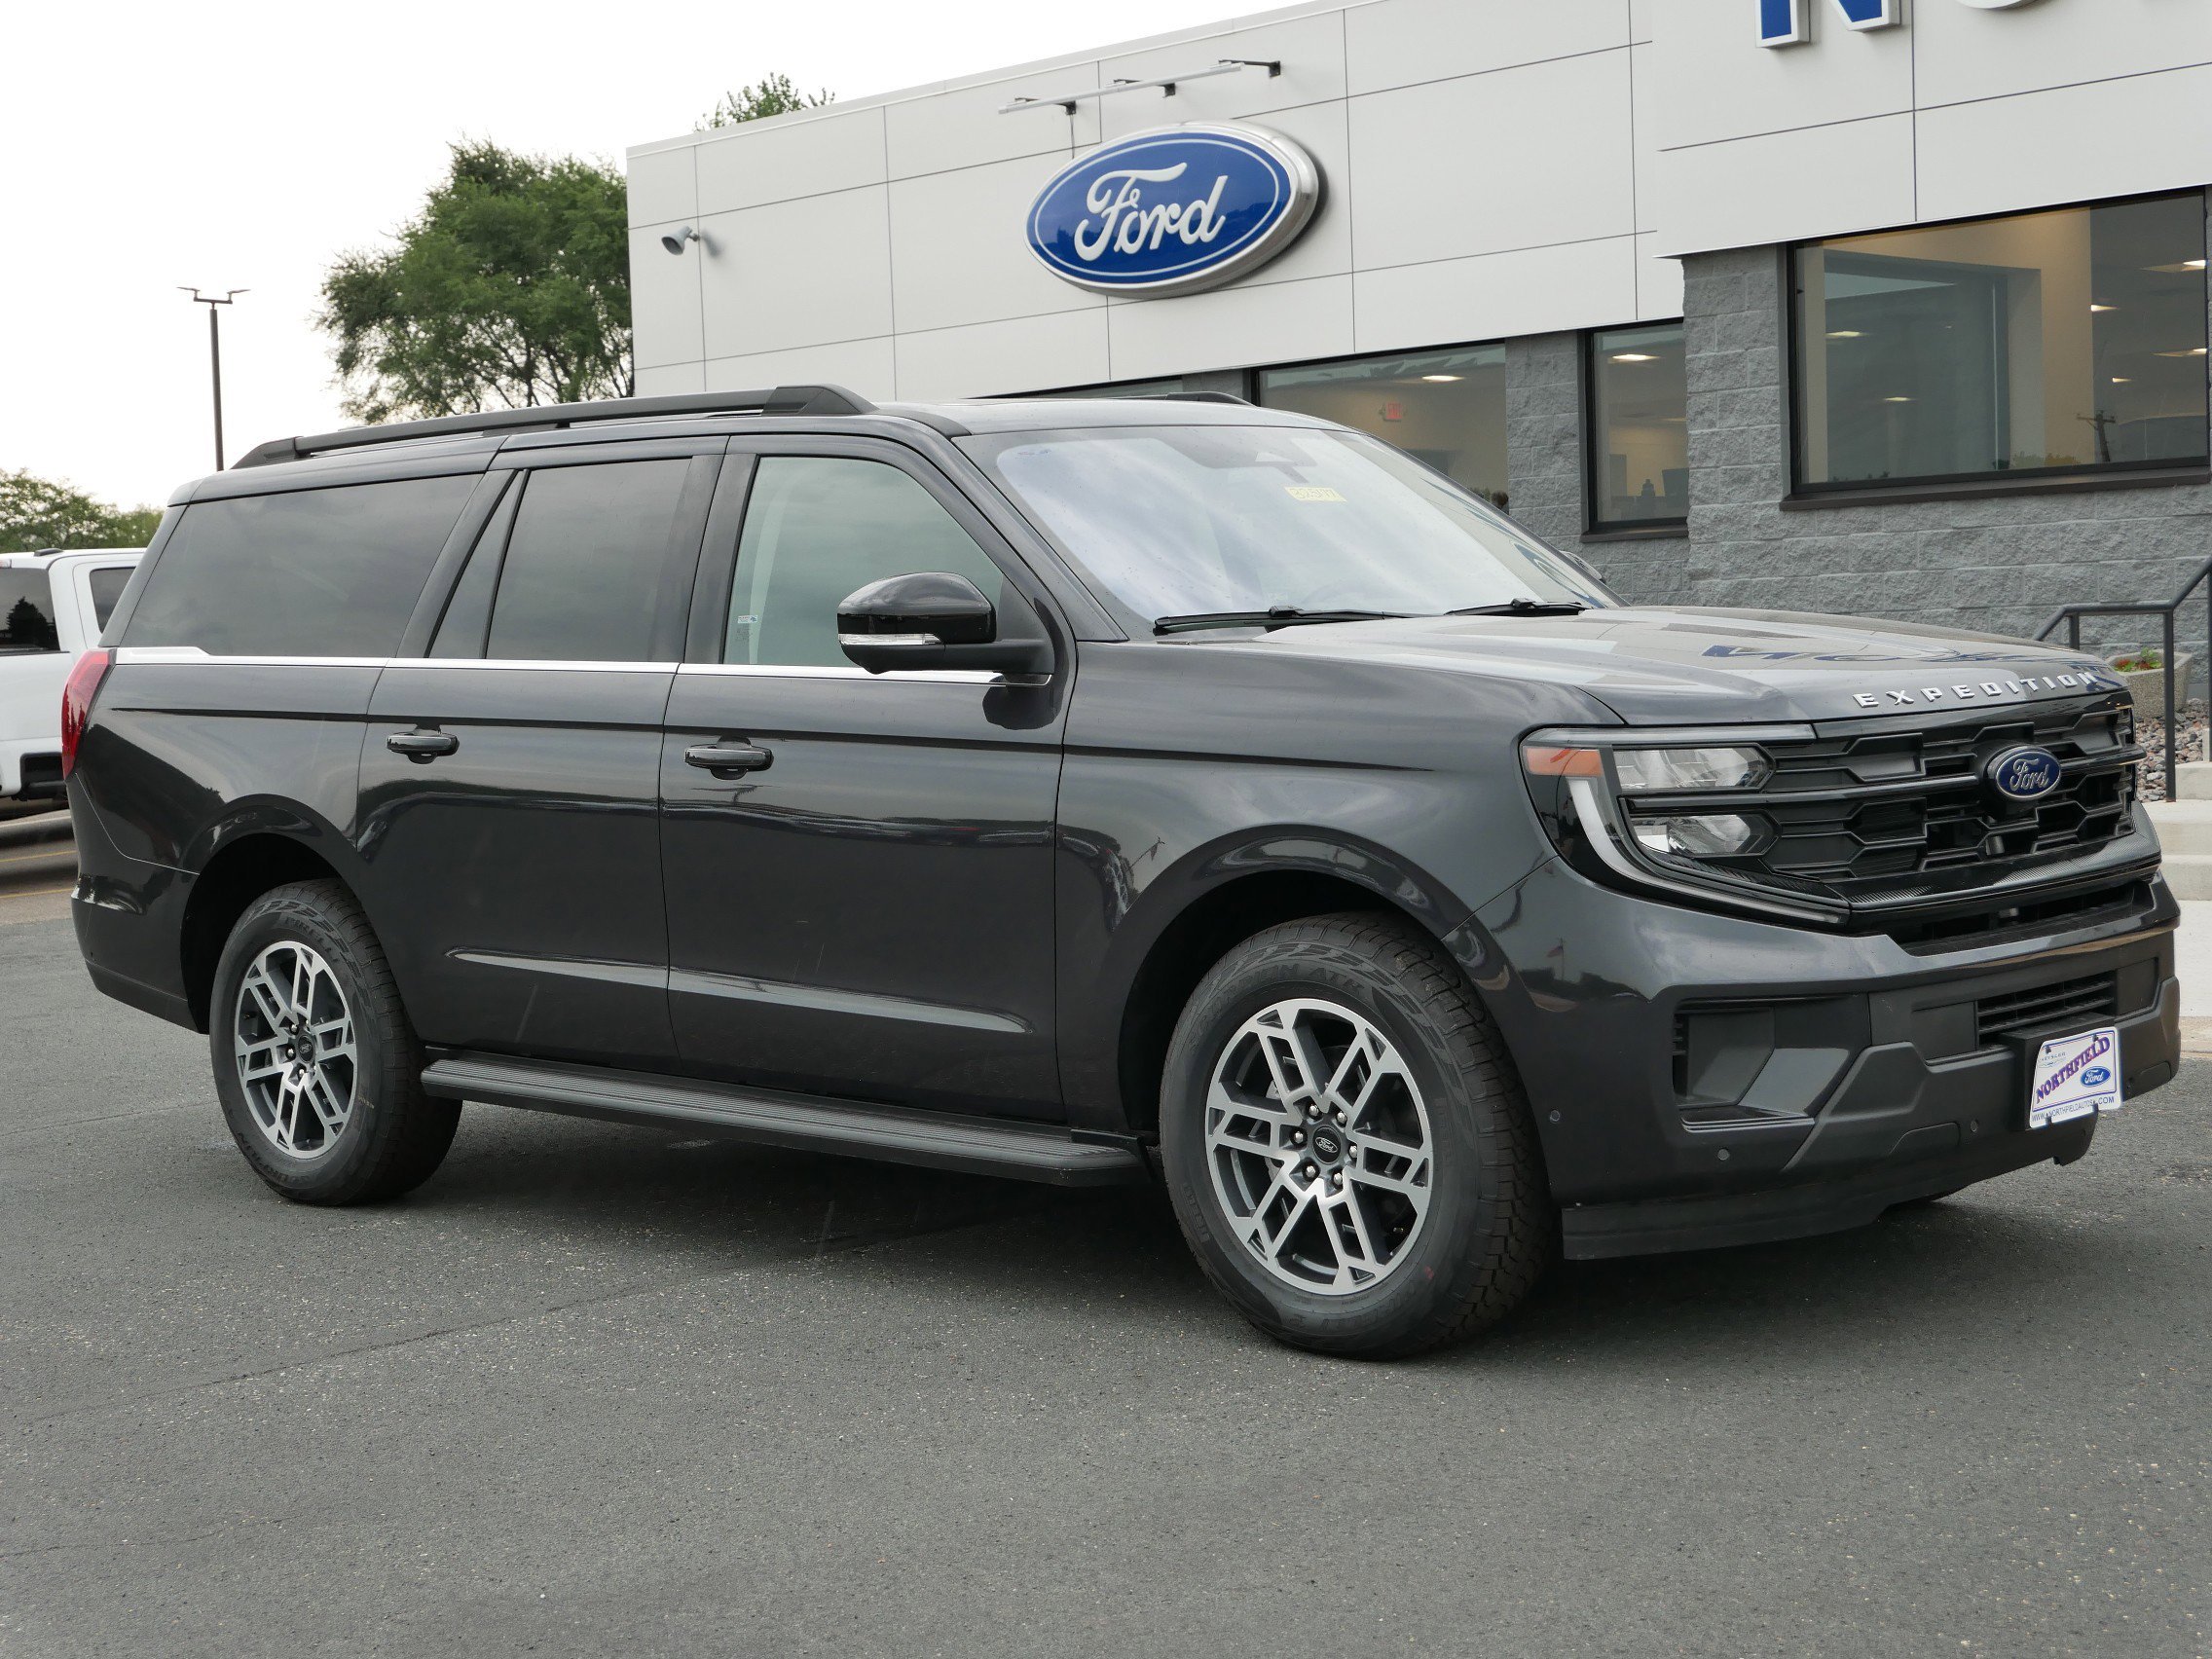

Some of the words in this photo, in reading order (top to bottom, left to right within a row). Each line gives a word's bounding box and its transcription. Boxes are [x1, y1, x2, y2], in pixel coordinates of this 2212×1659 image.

[1074, 162, 1229, 261] Ford
[1852, 671, 2099, 708] EXPEDITION
[2009, 757, 2049, 791] Ford
[2036, 1036, 2111, 1104] NORTHFIELD
[2084, 1069, 2104, 1084] Ford
